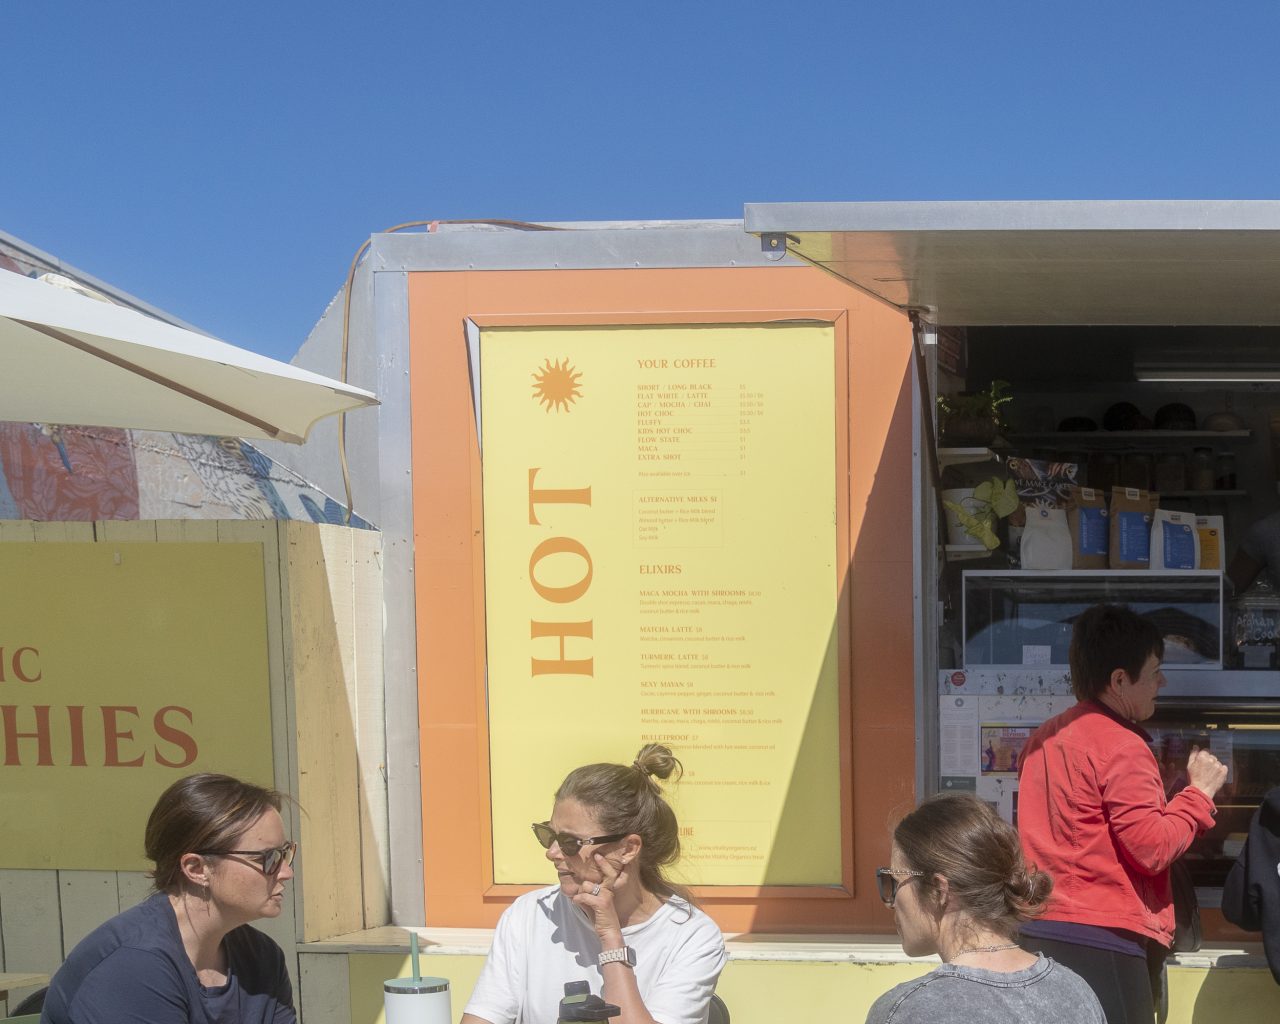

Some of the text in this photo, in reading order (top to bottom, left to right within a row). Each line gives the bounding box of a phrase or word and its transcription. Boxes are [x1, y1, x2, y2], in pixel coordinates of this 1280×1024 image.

[638, 359, 716, 369] YOUR COFFEE
[638, 453, 660, 461] EXTRA
[528, 467, 594, 679] HOT
[640, 565, 682, 574] ELIXIRS
[0, 705, 198, 768] HIES
